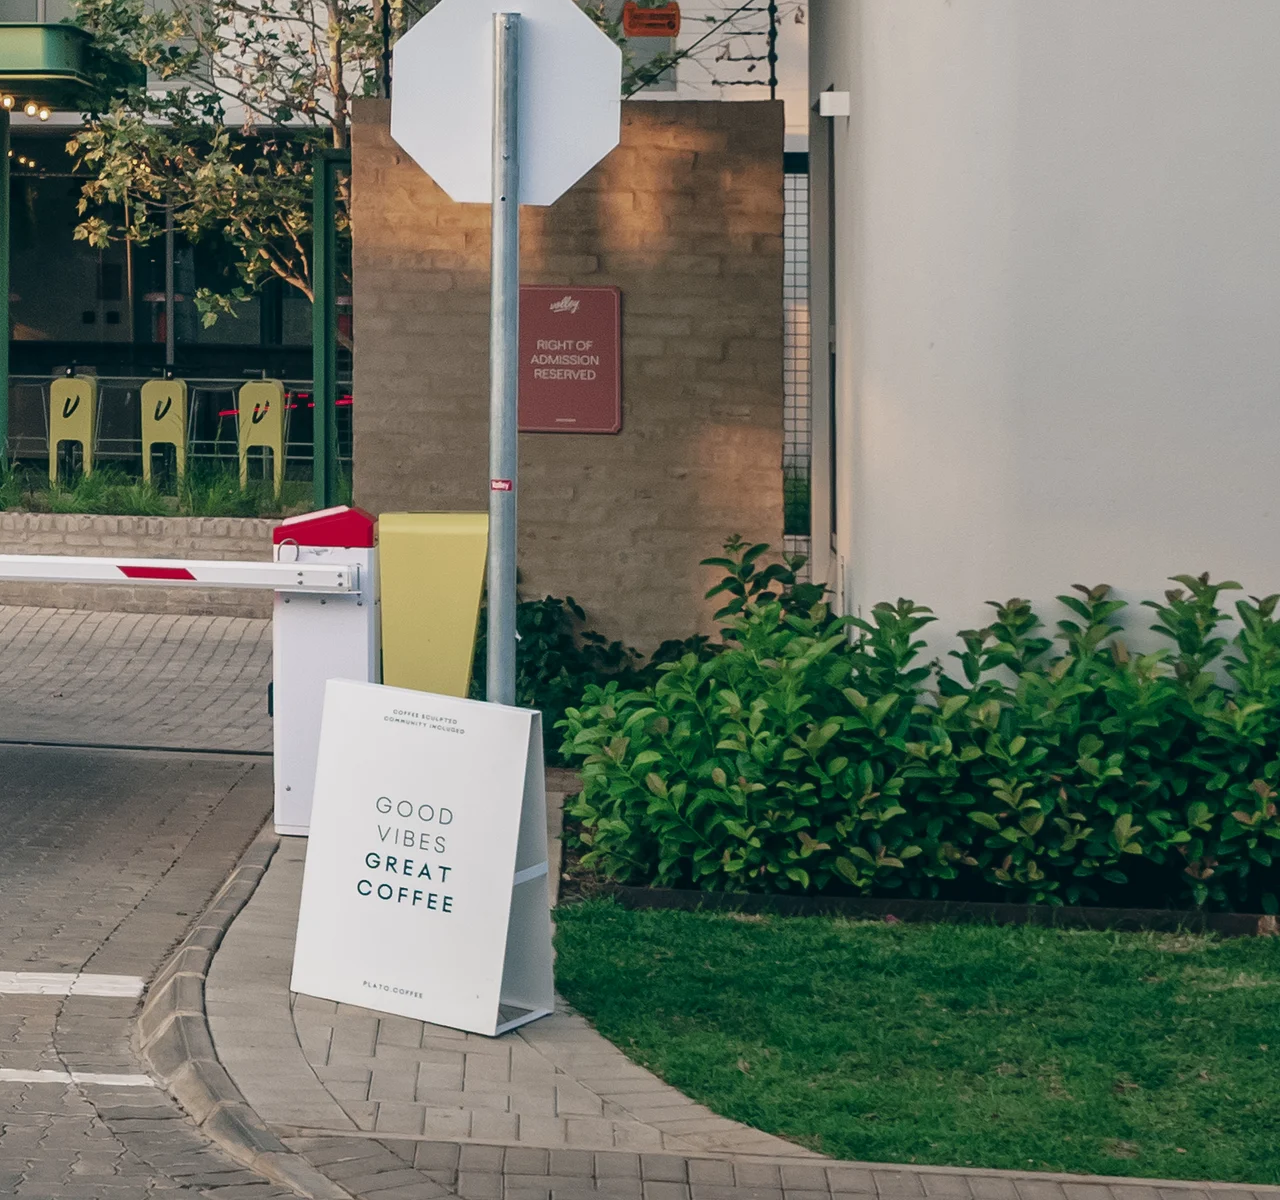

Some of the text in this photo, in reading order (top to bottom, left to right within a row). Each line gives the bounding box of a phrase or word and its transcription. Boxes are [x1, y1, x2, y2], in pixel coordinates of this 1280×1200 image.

[536, 339, 593, 351] RIGHT OF
[530, 354, 600, 365] ADMISSION
[534, 368, 596, 380] RESERVED
[392, 708, 419, 719] COFFEE
[383, 715, 427, 728] COMMUNITY
[376, 796, 453, 825] GOOD
[377, 824, 446, 854] VIBES
[365, 852, 452, 883] GREAT
[357, 879, 453, 913] COFFEE
